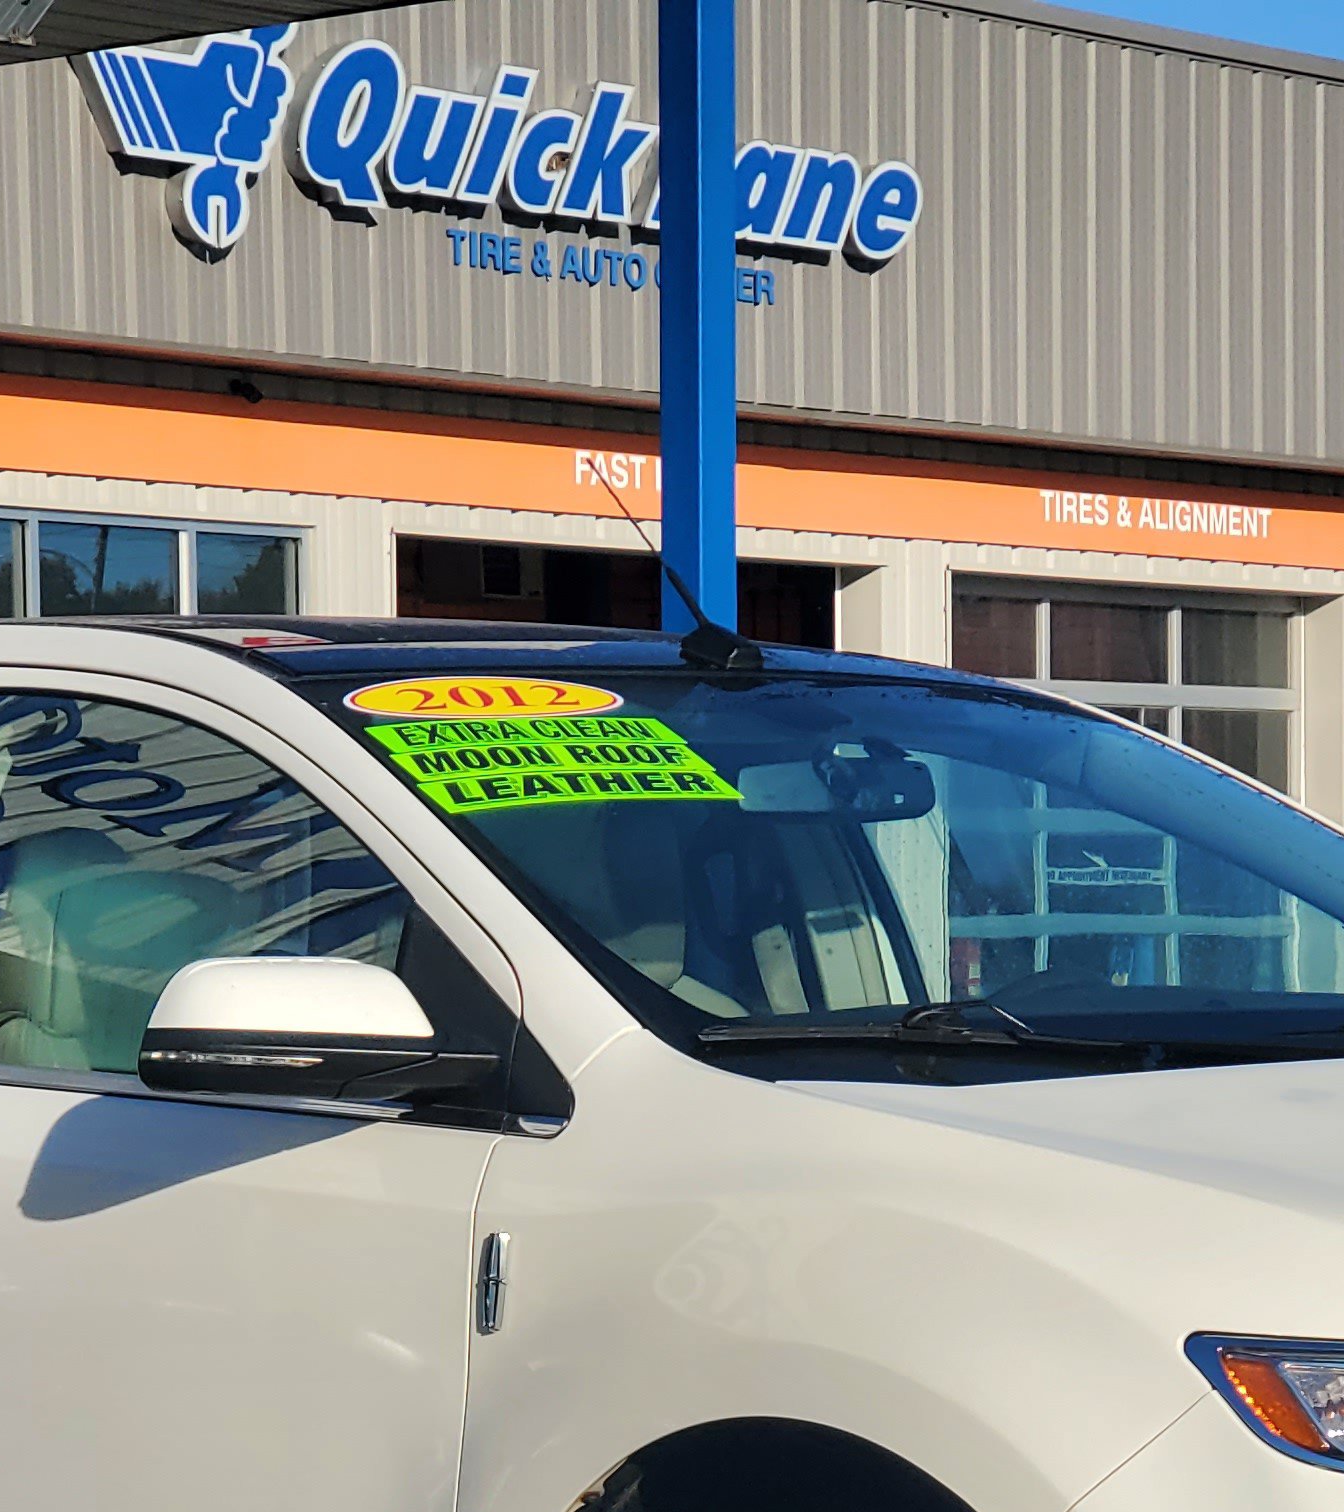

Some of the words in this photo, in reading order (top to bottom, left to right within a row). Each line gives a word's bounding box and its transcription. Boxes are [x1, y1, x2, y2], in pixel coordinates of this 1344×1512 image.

[299, 39, 660, 224] Quick
[644, 138, 923, 261] ane
[446, 228, 523, 275] TIRE
[531, 240, 552, 280] &
[560, 245, 648, 291] AUTO
[575, 448, 647, 490] FAST
[1039, 488, 1110, 526] TIRES
[1116, 495, 1133, 529] &
[1138, 497, 1273, 539] ALIGNMENT
[395, 684, 581, 712] 2012
[393, 720, 523, 748] EXTRA
[529, 718, 654, 742] CLEAN
[412, 744, 557, 776] MOON
[568, 743, 688, 768] ROOF
[443, 771, 716, 804] LEATHER
